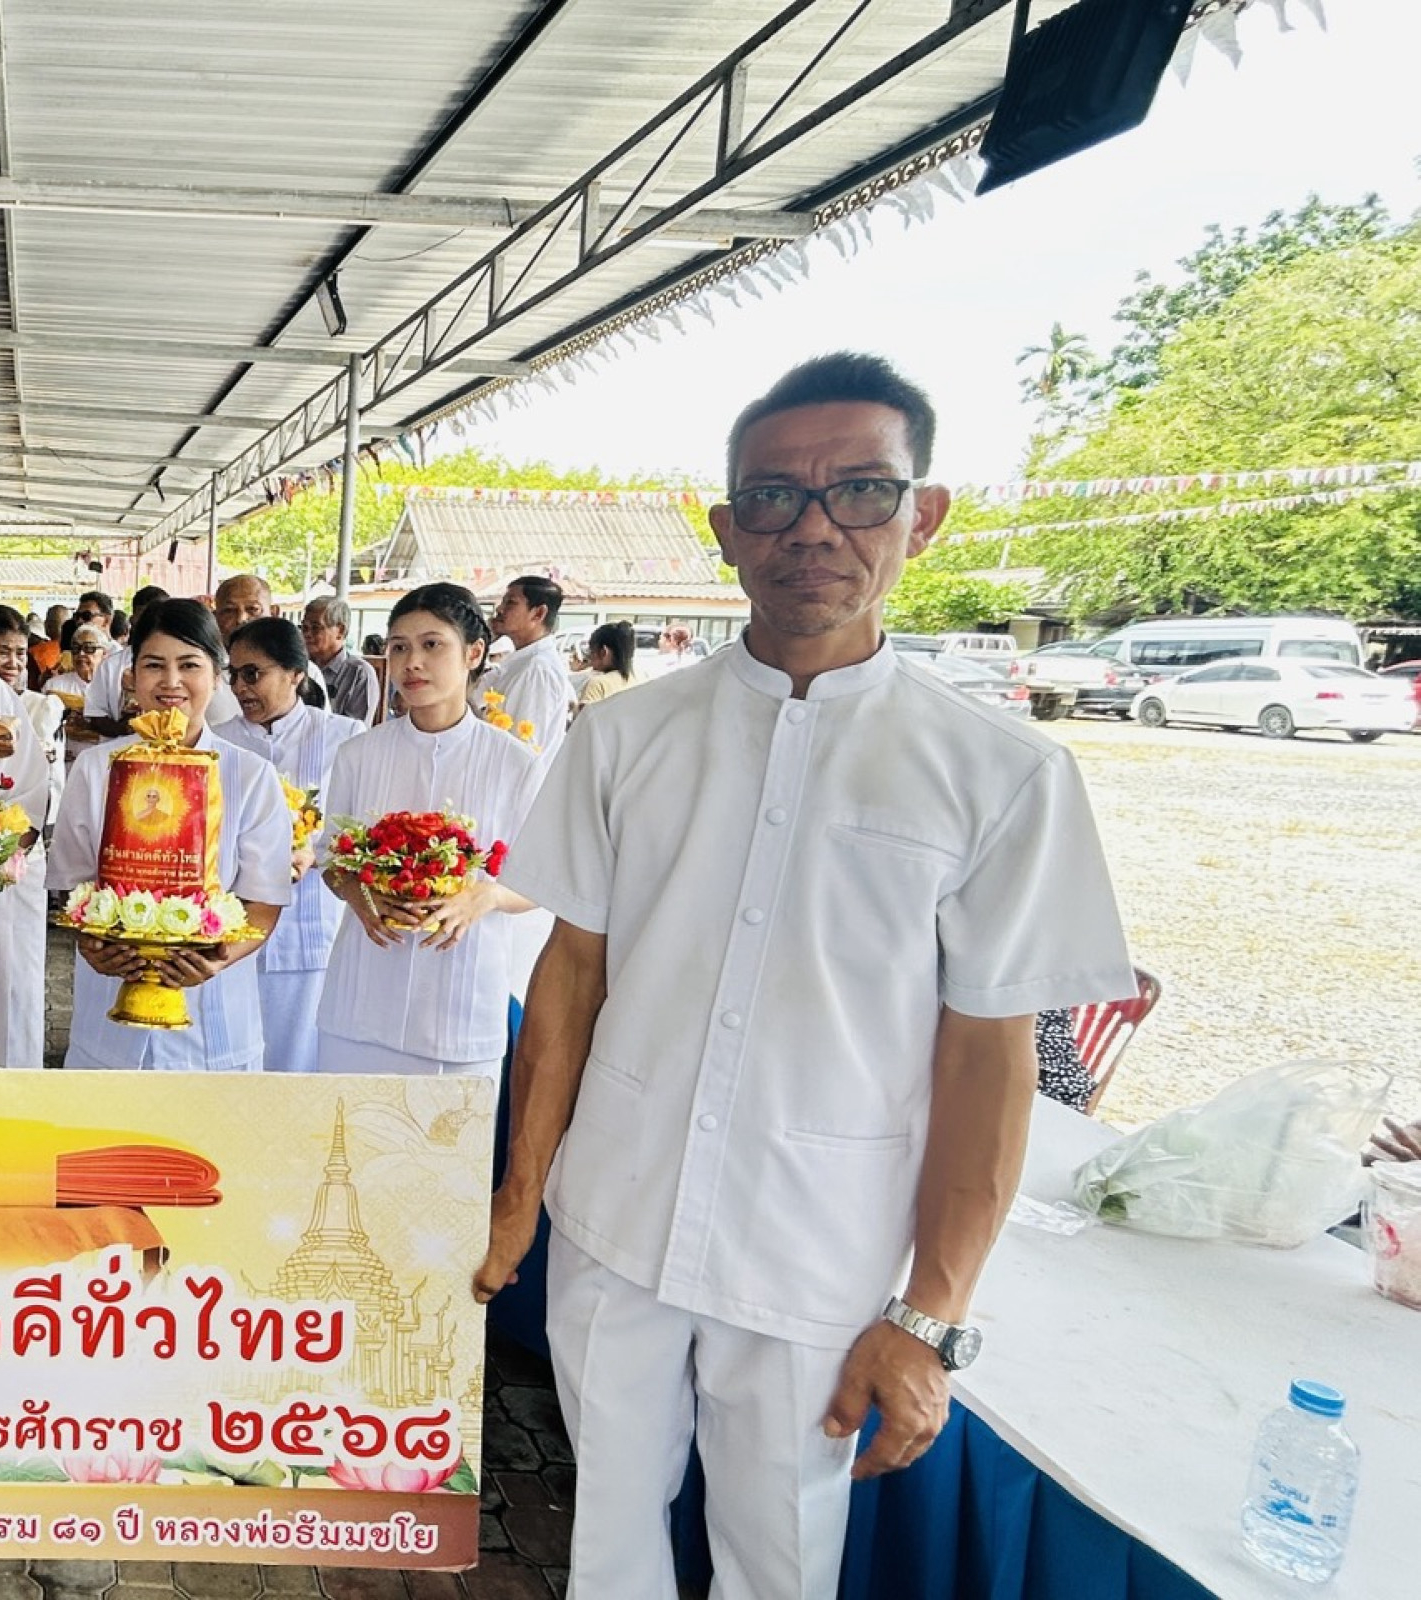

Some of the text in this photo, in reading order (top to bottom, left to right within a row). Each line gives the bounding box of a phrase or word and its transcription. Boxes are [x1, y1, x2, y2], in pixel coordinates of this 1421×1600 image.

[207, 1401, 451, 1461] ๒๕๖๘
[53, 1521, 100, 1542] ๘๑
[116, 1508, 140, 1541] ปี
[155, 1511, 435, 1550] หลวงพ่อธัมมชโย
